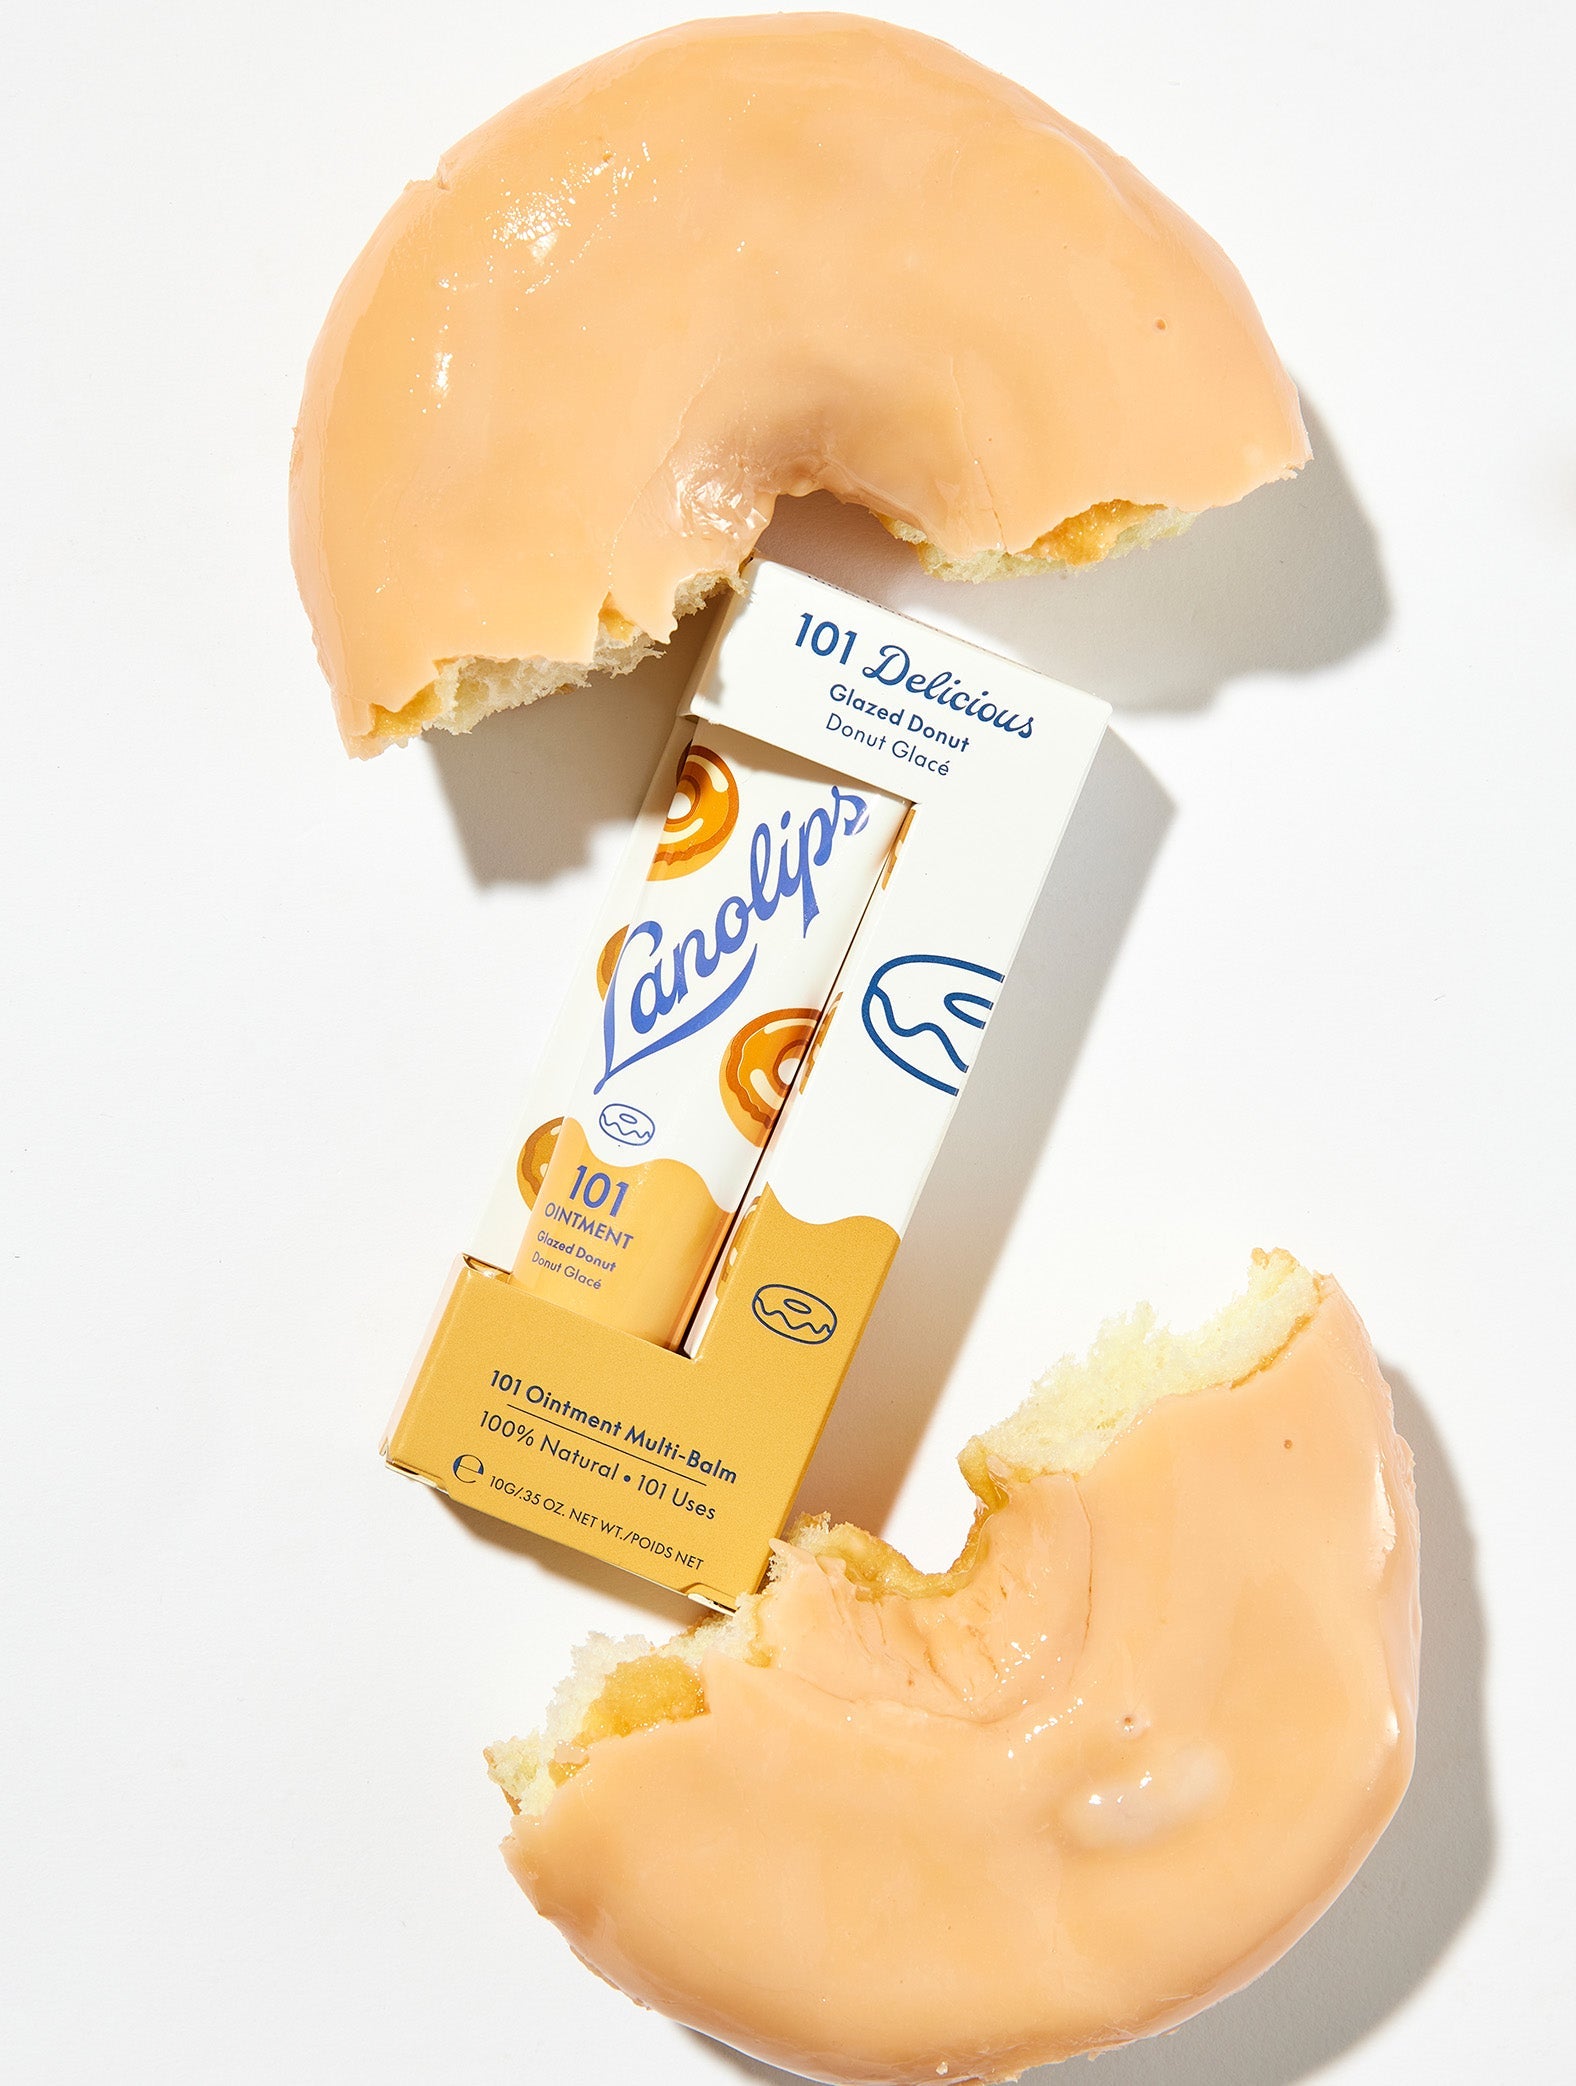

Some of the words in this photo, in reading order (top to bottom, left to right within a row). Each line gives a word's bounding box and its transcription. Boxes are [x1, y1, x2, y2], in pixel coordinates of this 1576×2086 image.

[795, 612, 857, 665] 101
[862, 644, 1033, 739] Delicious
[826, 712, 886, 751] Donut
[891, 740, 950, 776] Glacé
[830, 683, 904, 726] Glazed
[908, 715, 970, 753] Donut
[593, 785, 870, 1095] Lanolips
[545, 1202, 634, 1250] OINTMENT
[569, 1165, 629, 1217] 101
[532, 1251, 562, 1273] Donut
[564, 1265, 602, 1290] Glacé
[537, 1230, 575, 1254] Glazed
[576, 1247, 616, 1272] Donut
[490, 1370, 522, 1396] 101
[526, 1385, 622, 1436] Ointment
[624, 1426, 737, 1484] Multi-Balm
[480, 1410, 534, 1446] 100%
[540, 1435, 619, 1481] Natural
[637, 1474, 666, 1500] 101
[672, 1488, 716, 1520] Uses
[543, 1498, 565, 1517] OZ.
[570, 1507, 598, 1529] NET
[600, 1520, 673, 1559] WT./POIDS
[675, 1550, 704, 1571] NET
